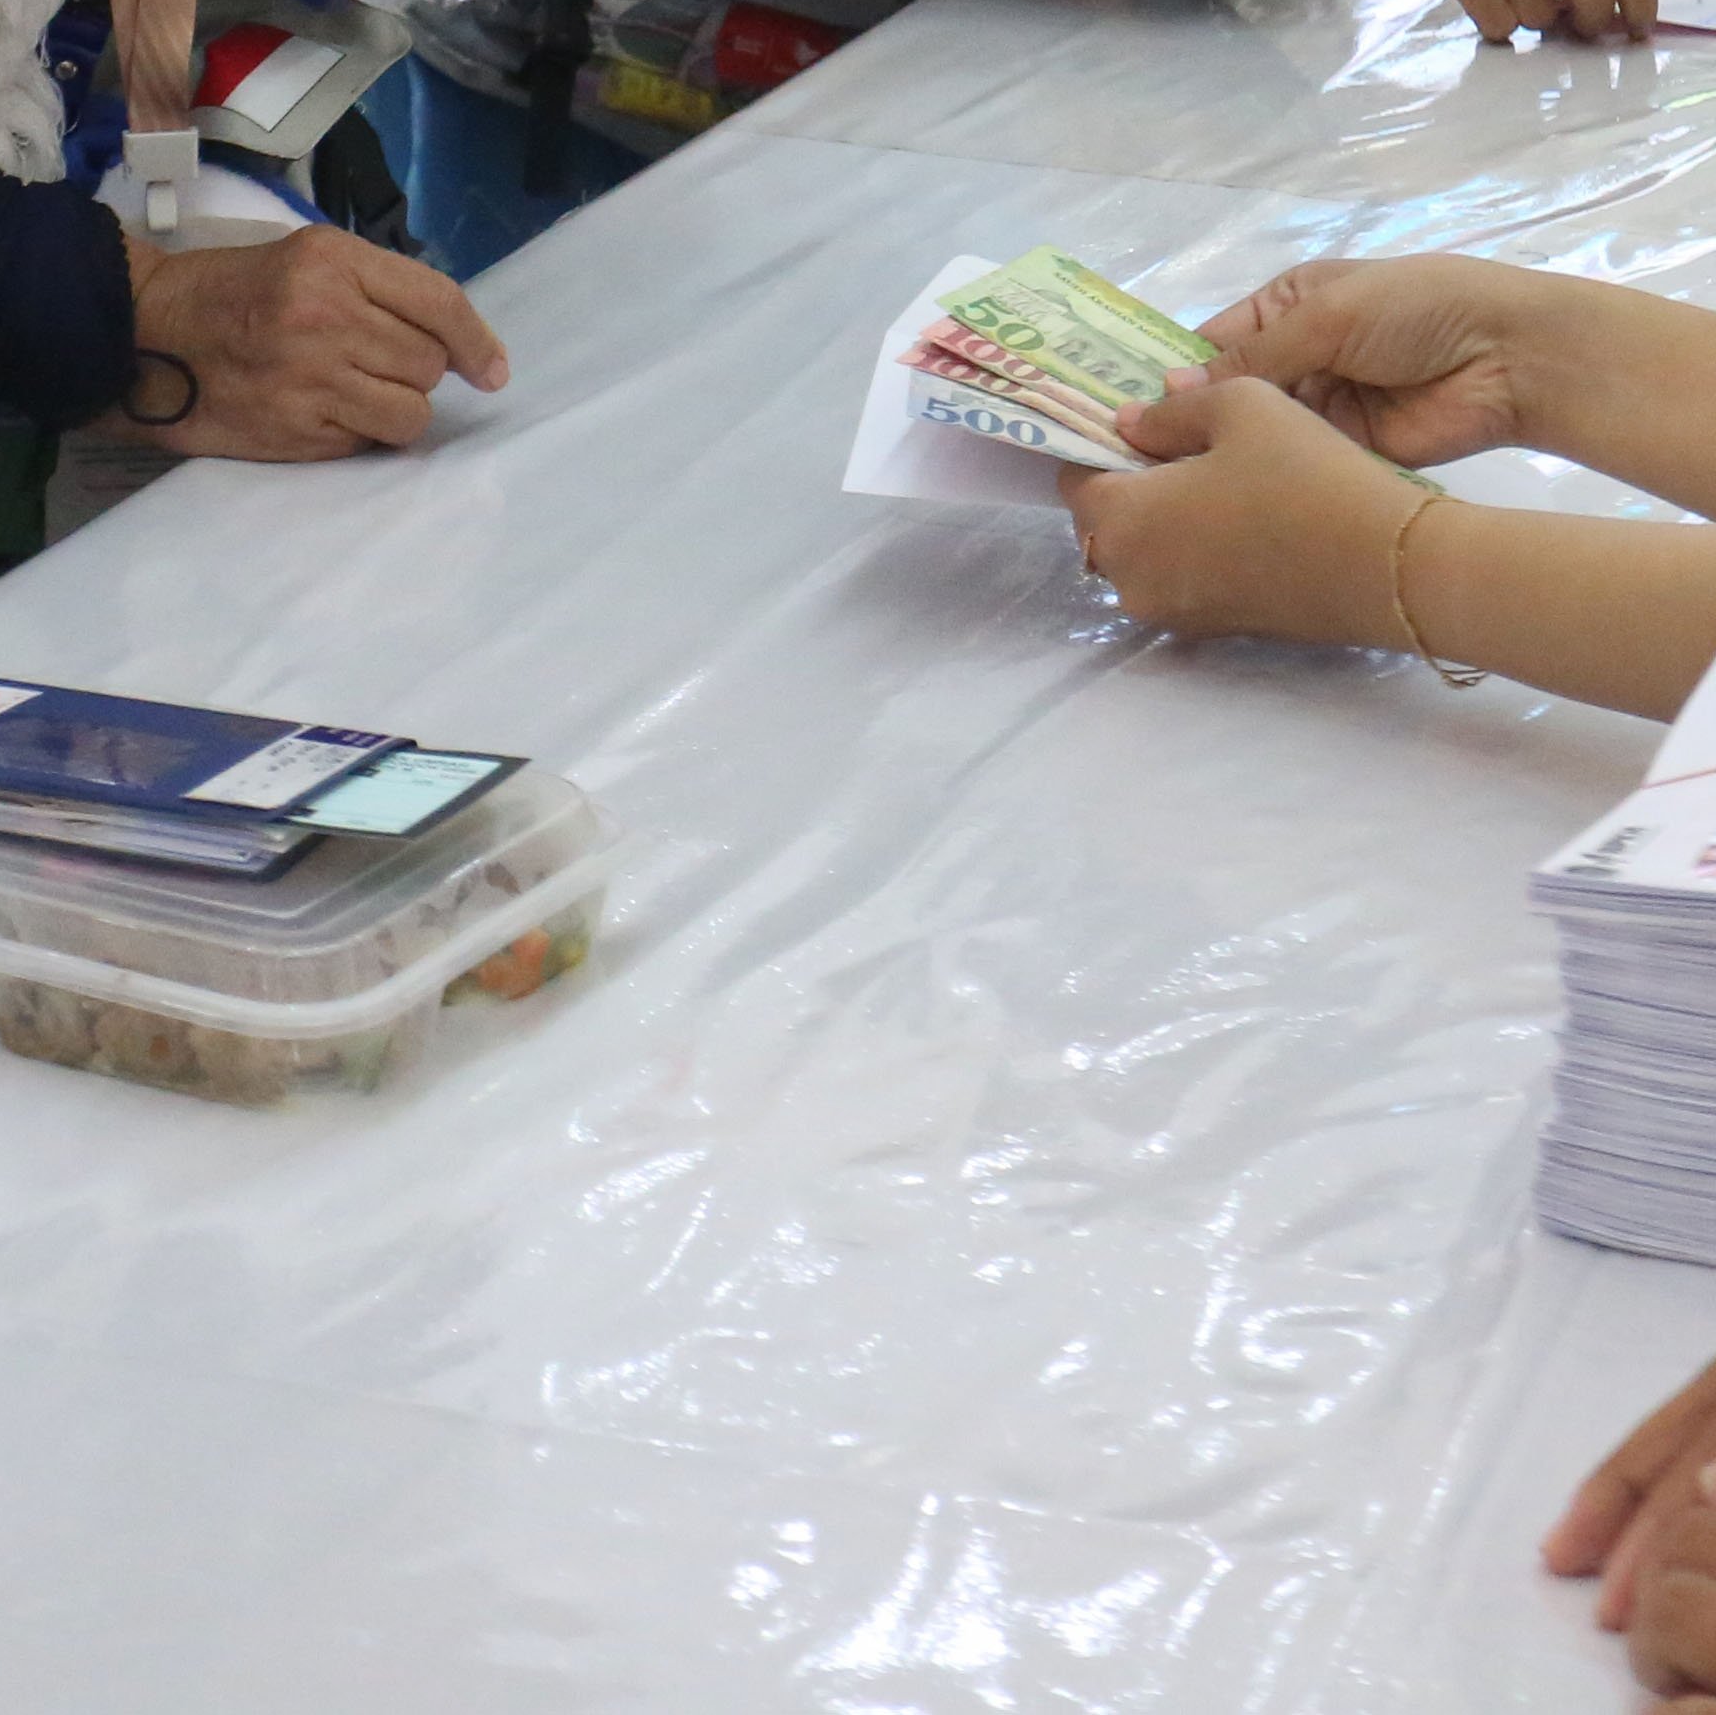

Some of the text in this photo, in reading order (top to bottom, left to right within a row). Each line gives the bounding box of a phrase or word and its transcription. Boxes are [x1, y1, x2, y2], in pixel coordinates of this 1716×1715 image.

[952, 296, 1046, 351] 50
[1087, 294, 1136, 326] ARABIAN
[939, 327, 1047, 381] 100
[921, 397, 1047, 447] 500
